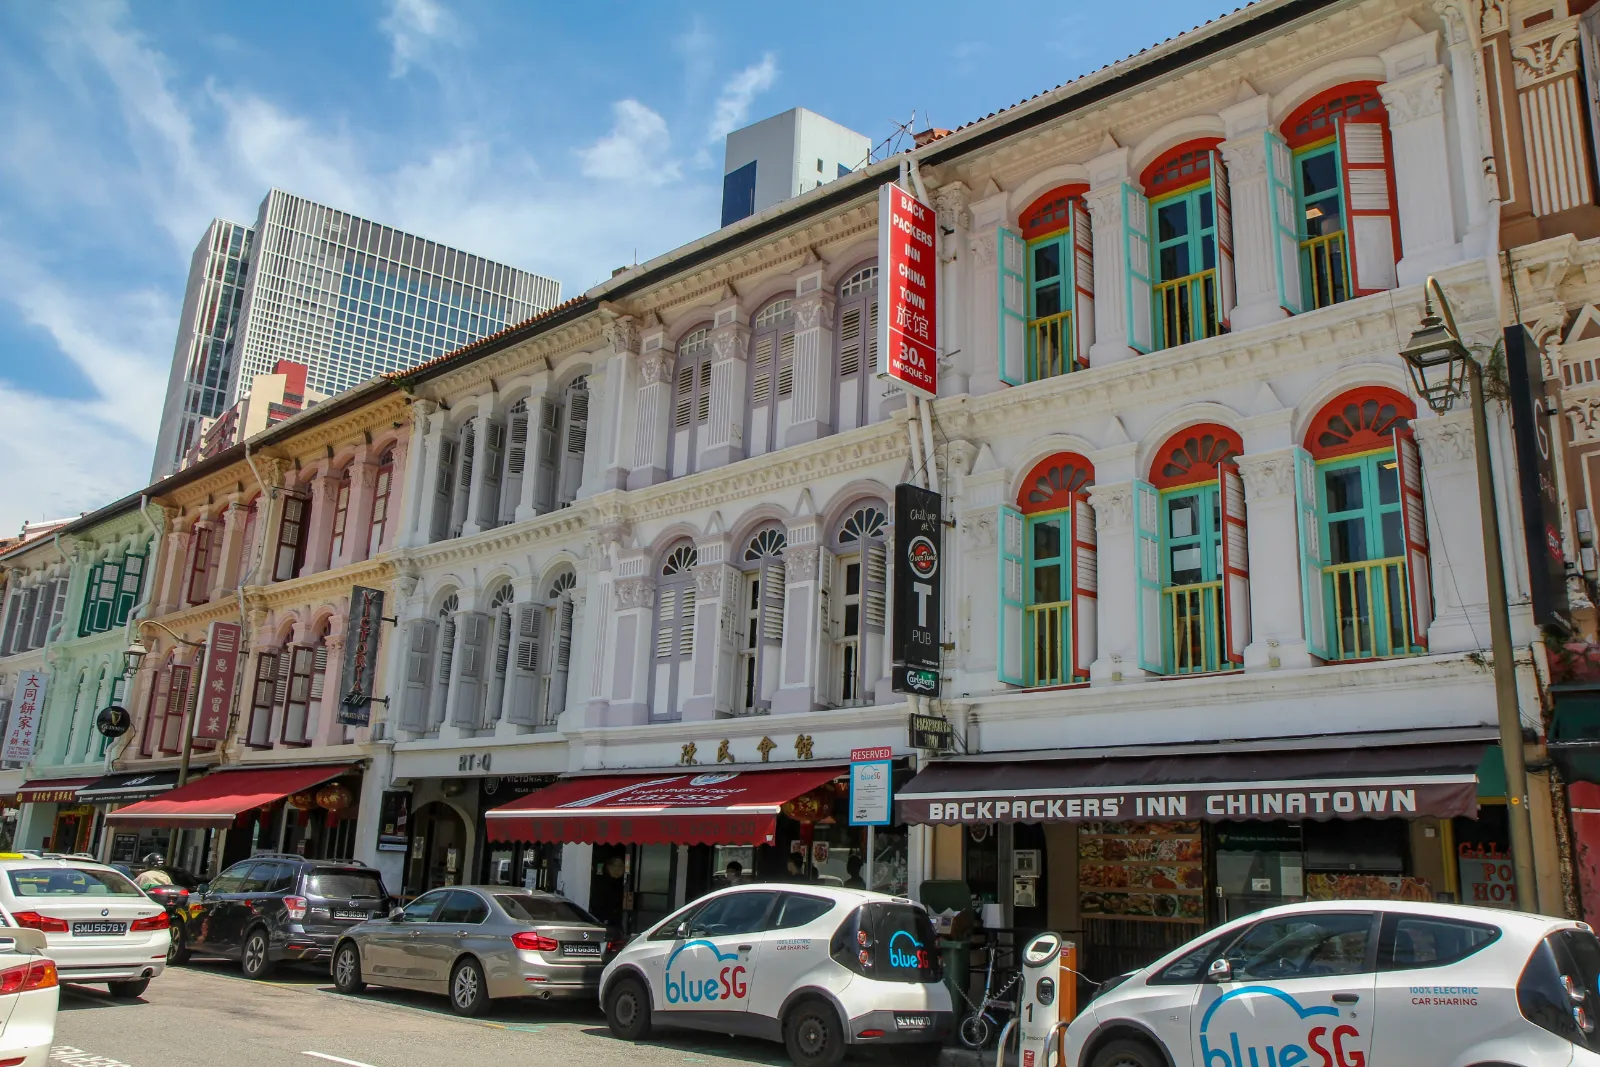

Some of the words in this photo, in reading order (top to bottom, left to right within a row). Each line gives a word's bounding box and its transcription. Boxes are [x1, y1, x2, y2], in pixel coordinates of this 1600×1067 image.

[901, 196, 925, 221] BACK
[893, 213, 933, 248] PACKERS
[905, 243, 921, 263] INN
[899, 263, 926, 288] CHINA
[900, 286, 926, 310] TOWN
[896, 303, 929, 340] 旅馆
[899, 341, 926, 370] 30A
[892, 358, 923, 380] MOSQUE
[924, 373, 932, 384] ST
[913, 582, 932, 627] T
[350, 590, 377, 694] VICTORIA
[912, 630, 932, 645] PUB
[907, 671, 935, 689] Carlsberg
[18, 674, 40, 729] 大同餅家
[852, 749, 890, 760] RESERVED
[861, 772, 881, 780] blueSG
[929, 796, 1125, 820] BACKPACKERS'
[1136, 796, 1187, 816] INN
[1206, 789, 1417, 815] CHINATOWN
[75, 924, 125, 933] SMU5678Y
[890, 948, 929, 968] blueSG
[665, 965, 747, 1004] blueSG
[1026, 1003, 1033, 1022] 1
[1433, 998, 1478, 1006] SHARING
